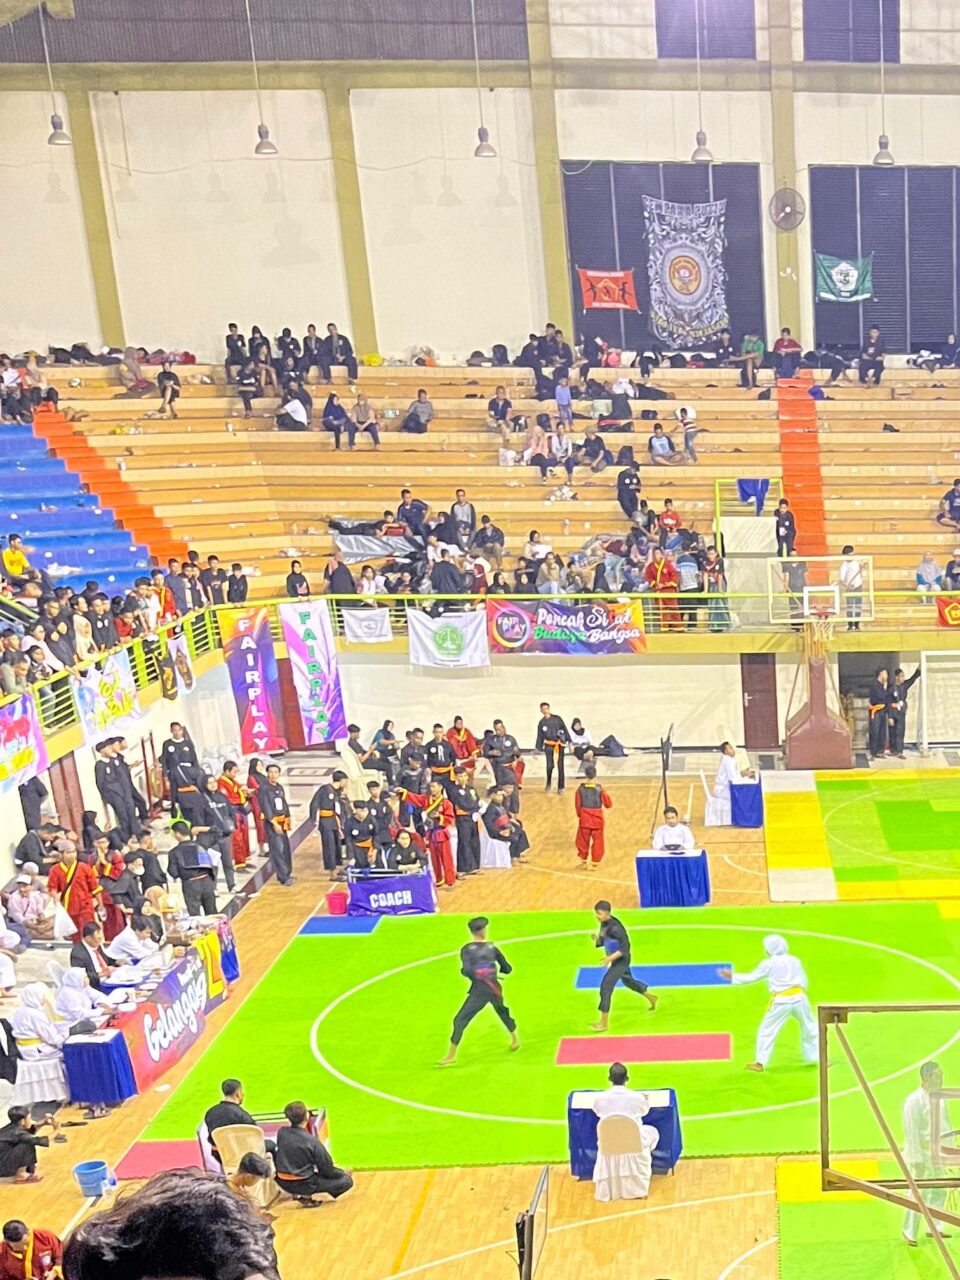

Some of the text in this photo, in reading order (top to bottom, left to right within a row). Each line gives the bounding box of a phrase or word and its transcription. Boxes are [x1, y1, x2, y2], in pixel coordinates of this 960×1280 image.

[537, 608, 585, 631] Pencak
[587, 627, 640, 644] Bangsa
[237, 619, 269, 750] FAIRPLAY
[298, 611, 330, 741] FAIRPLAY
[369, 889, 413, 908] COACH
